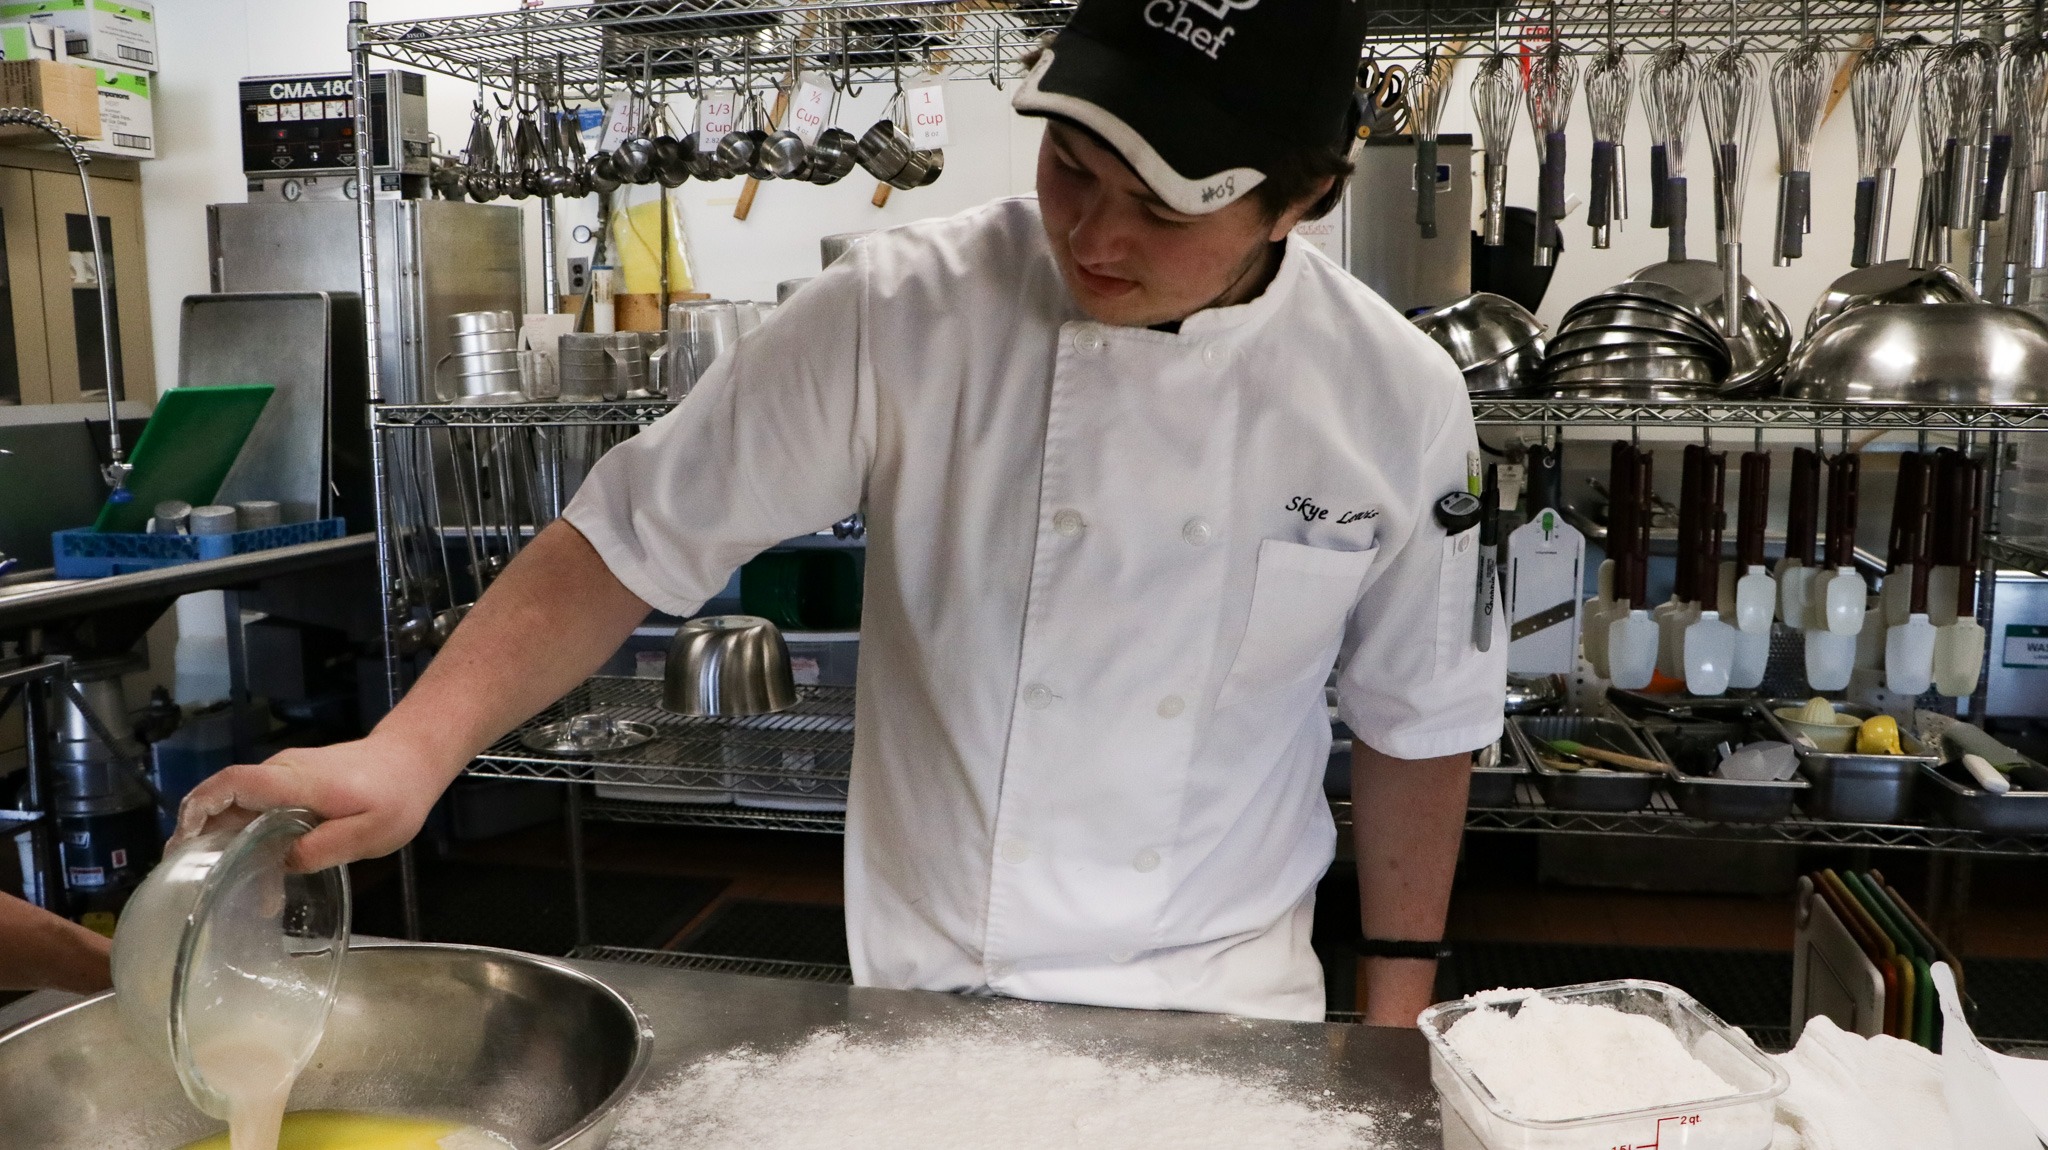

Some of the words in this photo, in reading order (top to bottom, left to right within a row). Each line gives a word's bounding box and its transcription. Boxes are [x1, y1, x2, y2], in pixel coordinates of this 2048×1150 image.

[1143, 0, 1236, 60] Chef
[923, 92, 931, 104] 1
[708, 104, 730, 116] 1/3
[796, 108, 820, 126] Cup
[917, 113, 943, 126] Cup
[706, 122, 731, 135] Cup
[1285, 496, 1329, 522] Skye
[1680, 1115, 1687, 1125] 2
[1689, 1114, 1702, 1125] qt.
